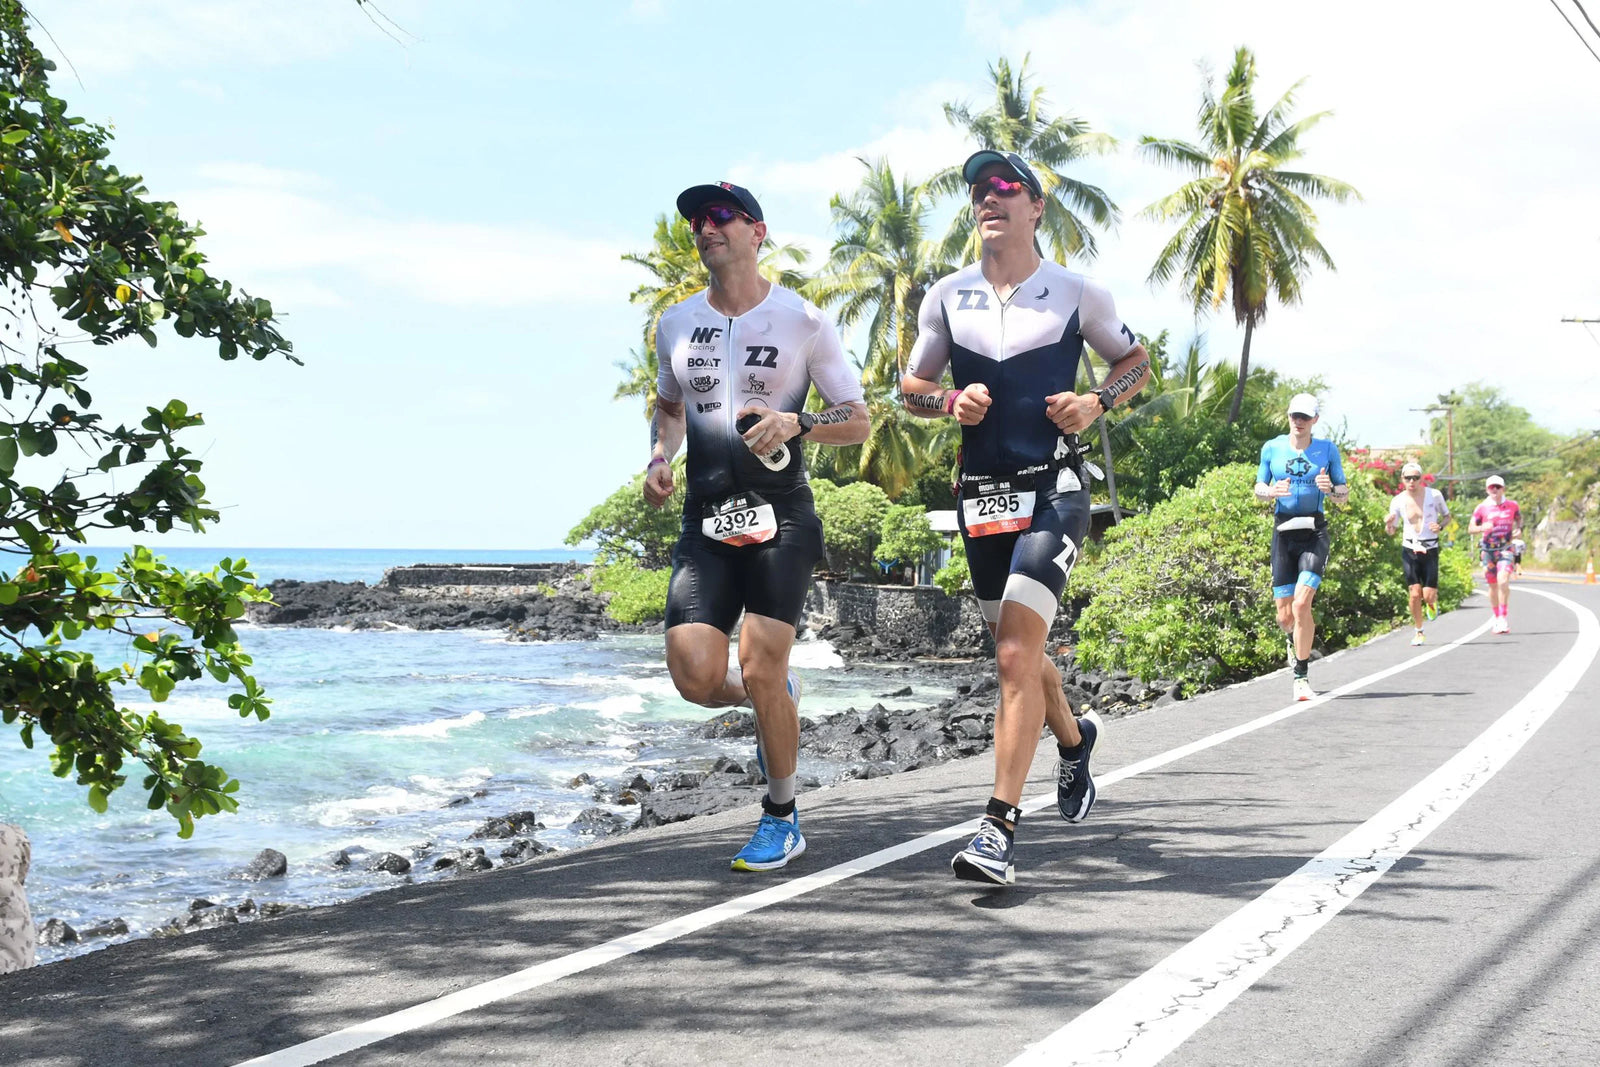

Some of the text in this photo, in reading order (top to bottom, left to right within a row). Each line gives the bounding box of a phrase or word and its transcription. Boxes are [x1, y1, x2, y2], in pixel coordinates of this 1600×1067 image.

[957, 290, 990, 310] Z2
[688, 343, 716, 352] Racing
[744, 346, 779, 369] Z2
[687, 358, 721, 367] BOAT
[977, 495, 1019, 516] 2295
[714, 509, 759, 534] 2392
